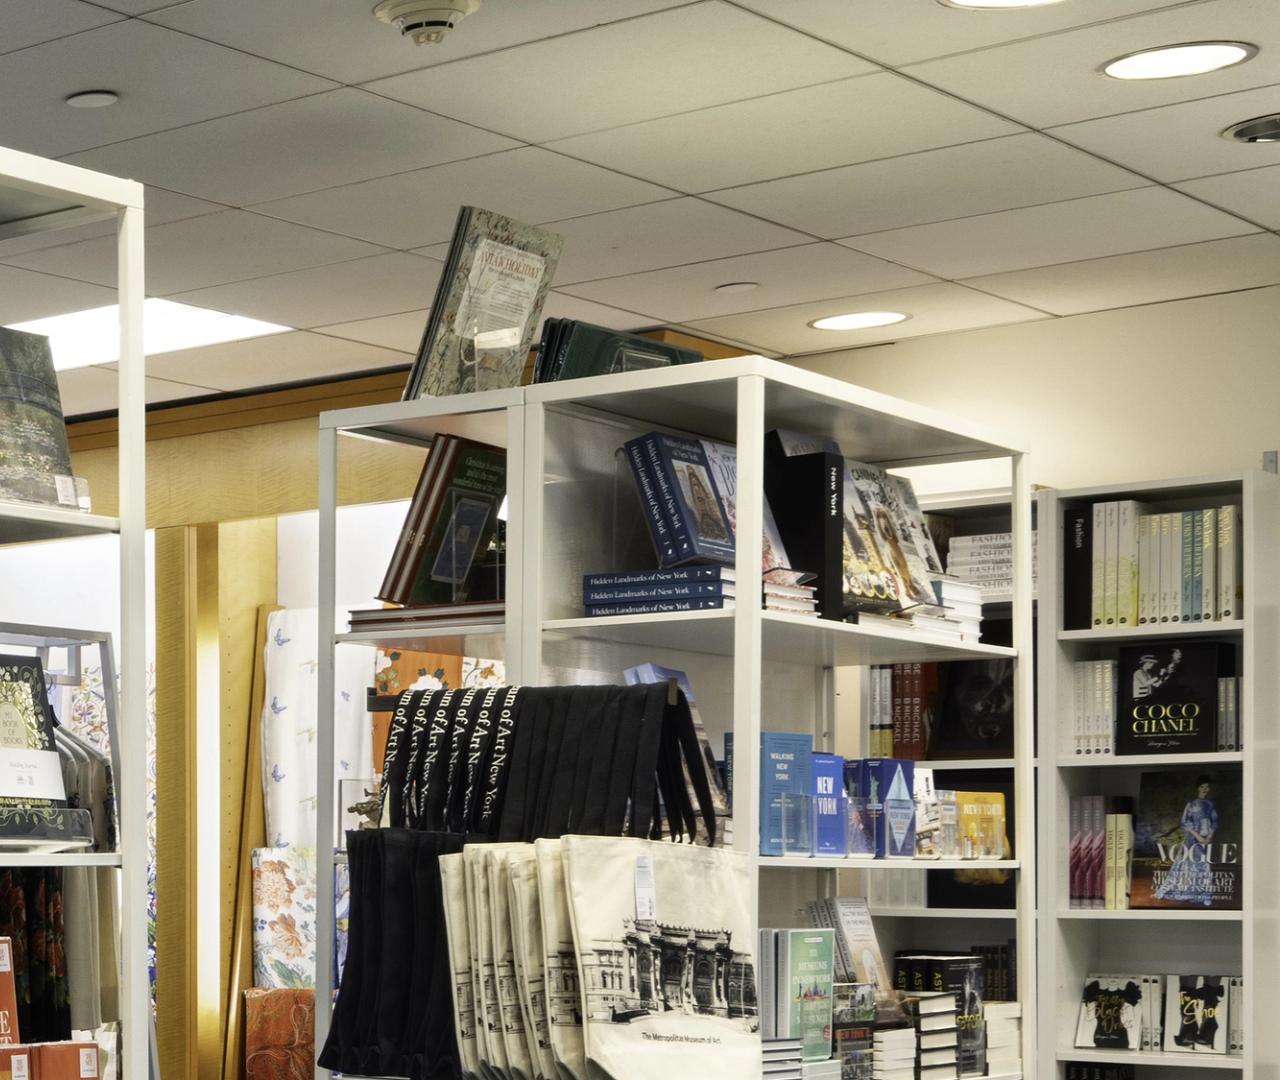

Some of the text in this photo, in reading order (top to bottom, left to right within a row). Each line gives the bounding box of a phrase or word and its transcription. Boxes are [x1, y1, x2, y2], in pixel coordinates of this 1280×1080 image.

[1074, 518, 1084, 548] Fashion
[591, 577, 613, 585] Hidden
[614, 575, 647, 583] Landmarks
[648, 573, 656, 581] of
[673, 571, 688, 579] York
[591, 592, 613, 600] Hidden
[615, 590, 648, 598] Landmarks
[649, 588, 656, 597] of
[674, 586, 689, 594] York
[592, 601, 690, 615] Hidden Landmarks of New York
[434, 710, 448, 726] of
[500, 709, 514, 726] of
[1132, 703, 1200, 720] COCO
[387, 708, 407, 748] of Art
[411, 709, 427, 749] of Art
[451, 709, 469, 749] of Art
[469, 710, 491, 749] of Art
[912, 705, 920, 744] MICHAEL
[1132, 718, 1200, 733] CHANEL
[3, 736, 23, 744] BOOKS
[428, 725, 446, 748] Art
[494, 726, 512, 751] Art
[490, 753, 507, 785] New
[817, 777, 834, 794] NEW
[818, 798, 837, 815] YORK
[1155, 843, 1238, 863] VOGUE
[1211, 878, 1235, 886] ART
[652, 1033, 683, 1042] Metropolitan
